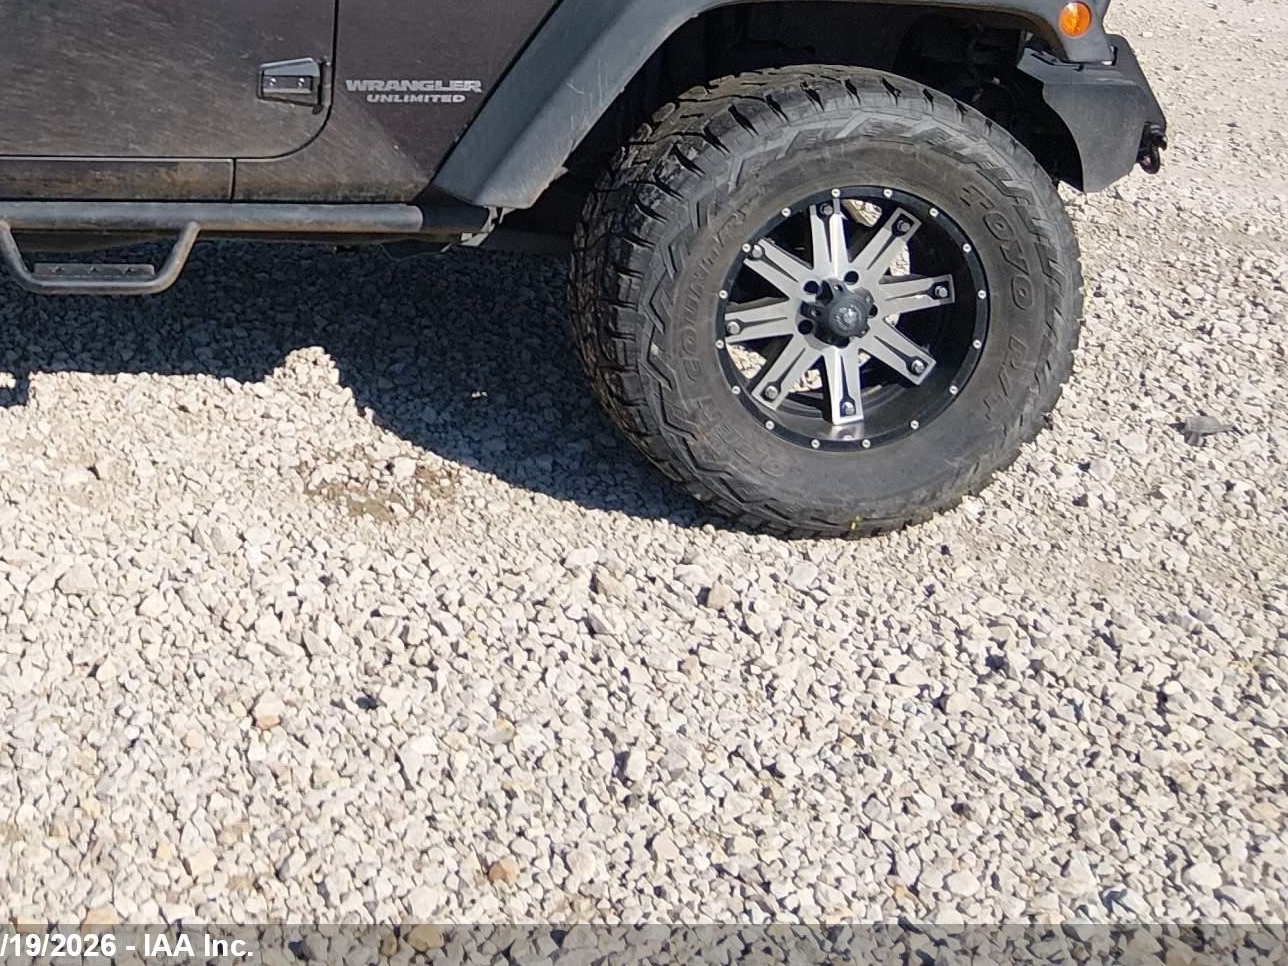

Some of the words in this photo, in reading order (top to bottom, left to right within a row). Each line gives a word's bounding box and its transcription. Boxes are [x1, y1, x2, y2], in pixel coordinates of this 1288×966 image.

[345, 80, 482, 93] WRANGLER
[366, 94, 466, 103] UNLIMITED
[959, 184, 1033, 311] TOYO
